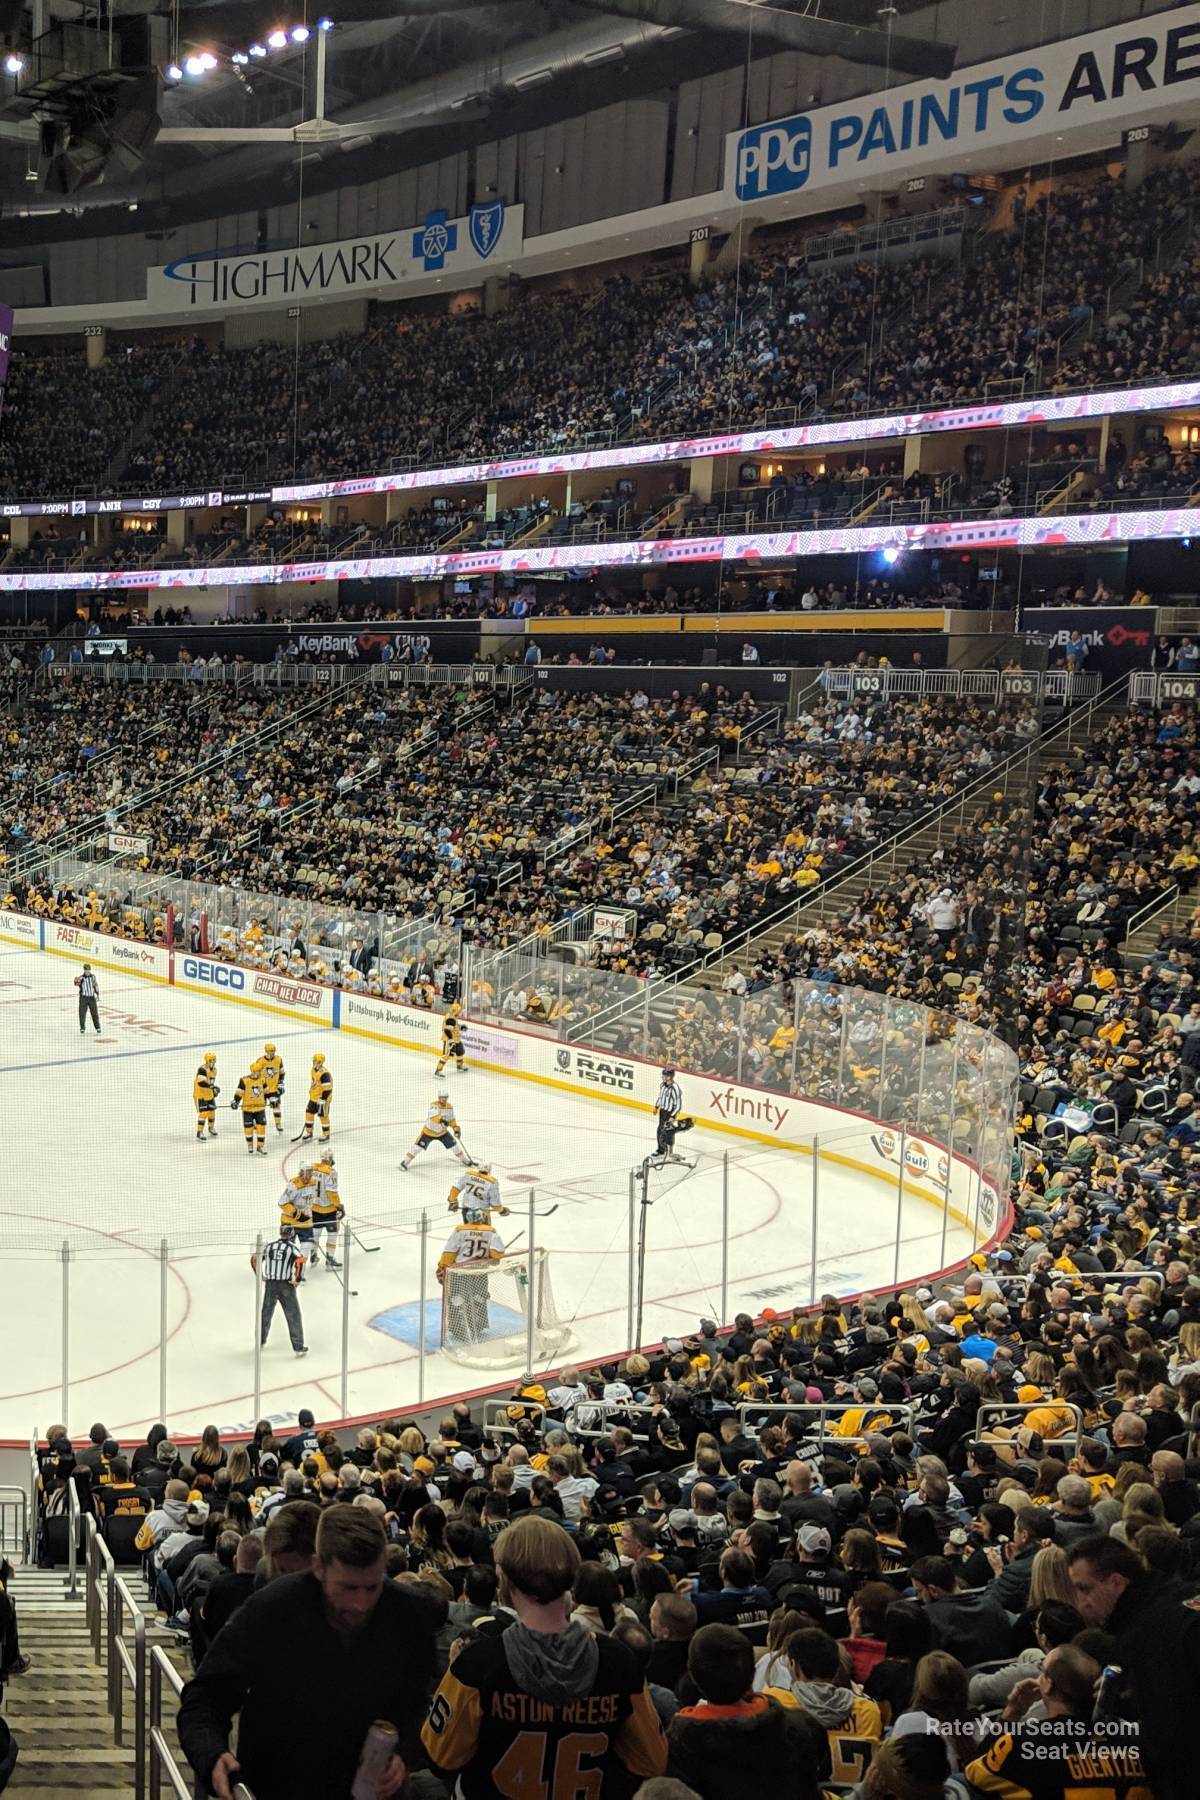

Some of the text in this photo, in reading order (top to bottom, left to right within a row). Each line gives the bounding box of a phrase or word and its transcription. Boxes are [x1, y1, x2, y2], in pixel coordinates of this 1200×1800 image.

[739, 129, 810, 192] PPG
[829, 67, 1044, 168] PAINTS
[692, 228, 709, 242] 201
[191, 238, 397, 303] HIGHMARK
[84, 326, 102, 336] 232
[41, 503, 69, 514] 9:00PM
[99, 501, 122, 512] ANH
[142, 499, 162, 510] CGY
[179, 495, 205, 507] 9:00PM
[3, 505, 22, 515] COL
[299, 635, 357, 655] KeyBank
[52, 667, 67, 677] 121
[316, 670, 330, 681] 122
[389, 670, 402, 681] 101
[474, 670, 490, 682] 101
[537, 670, 549, 680] 102
[772, 673, 787, 683] 102
[855, 676, 880, 692] 103
[1005, 677, 1032, 694] 103
[1164, 682, 1196, 698] 104
[57, 926, 78, 943] FAST
[112, 945, 140, 961] KeyBank
[183, 958, 245, 990] GEICO
[347, 999, 431, 1031] Pittsburgh Post-Gazette
[576, 1056, 634, 1080] RAM
[576, 1069, 634, 1091] 1500
[709, 1088, 790, 1131] xfinity
[879, 1137, 895, 1149] Gulf
[904, 1151, 928, 1169] Gulf
[464, 1182, 485, 1201] 76
[273, 1248, 284, 1260] 15
[462, 1238, 488, 1258] 35
[490, 1730, 609, 1800] 46
